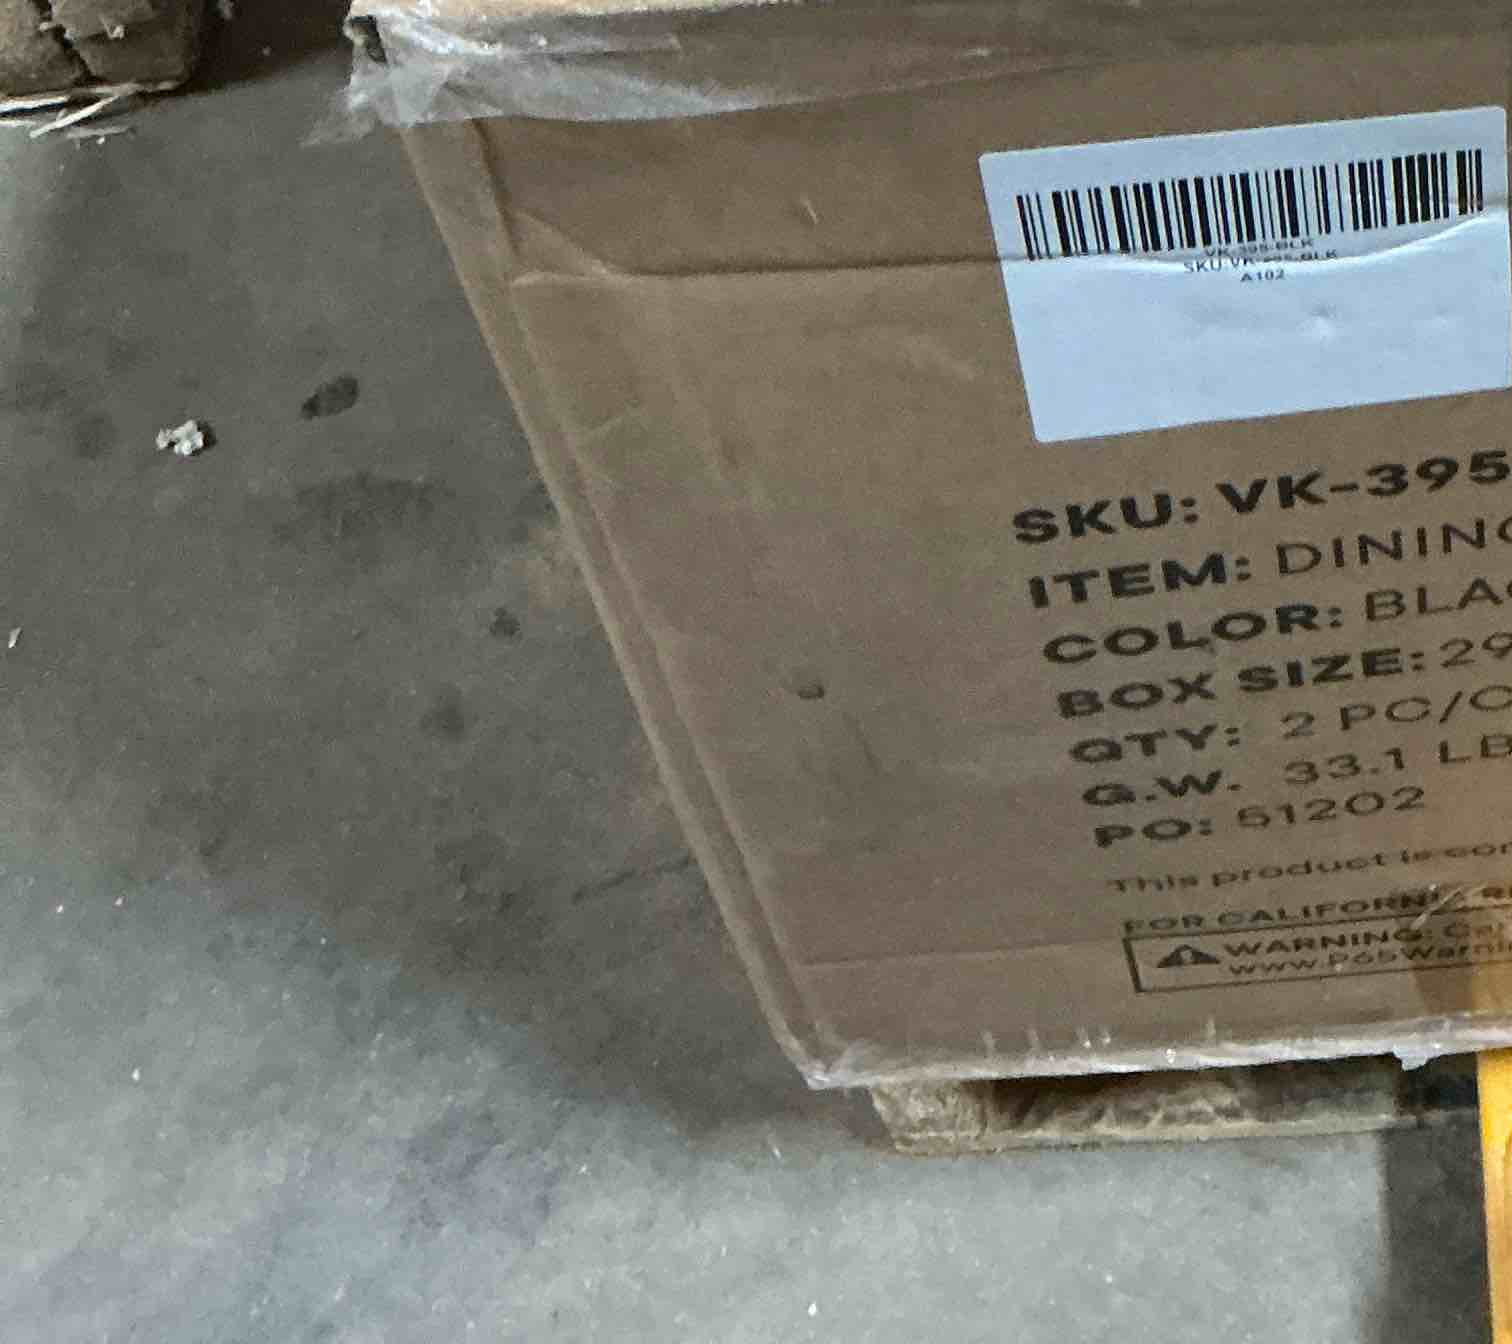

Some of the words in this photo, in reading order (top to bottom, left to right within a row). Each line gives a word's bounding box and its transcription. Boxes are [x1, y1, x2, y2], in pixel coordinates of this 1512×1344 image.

[1240, 269, 1286, 283] A102
[1012, 492, 1200, 546] SKU:
[1028, 552, 1251, 608] ITEM:
[1042, 602, 1342, 664] COLOR:
[1056, 673, 1218, 718] BOX
[1236, 647, 1425, 694] SIZE:
[1068, 723, 1239, 763] QTY:
[1279, 711, 1316, 740] 2
[1283, 749, 1410, 788] 33.1
[1093, 816, 1214, 848] PO:
[1107, 872, 1199, 895] This
[1210, 850, 1387, 889] product
[1400, 846, 1432, 863] is
[1124, 912, 1206, 934] FOR
